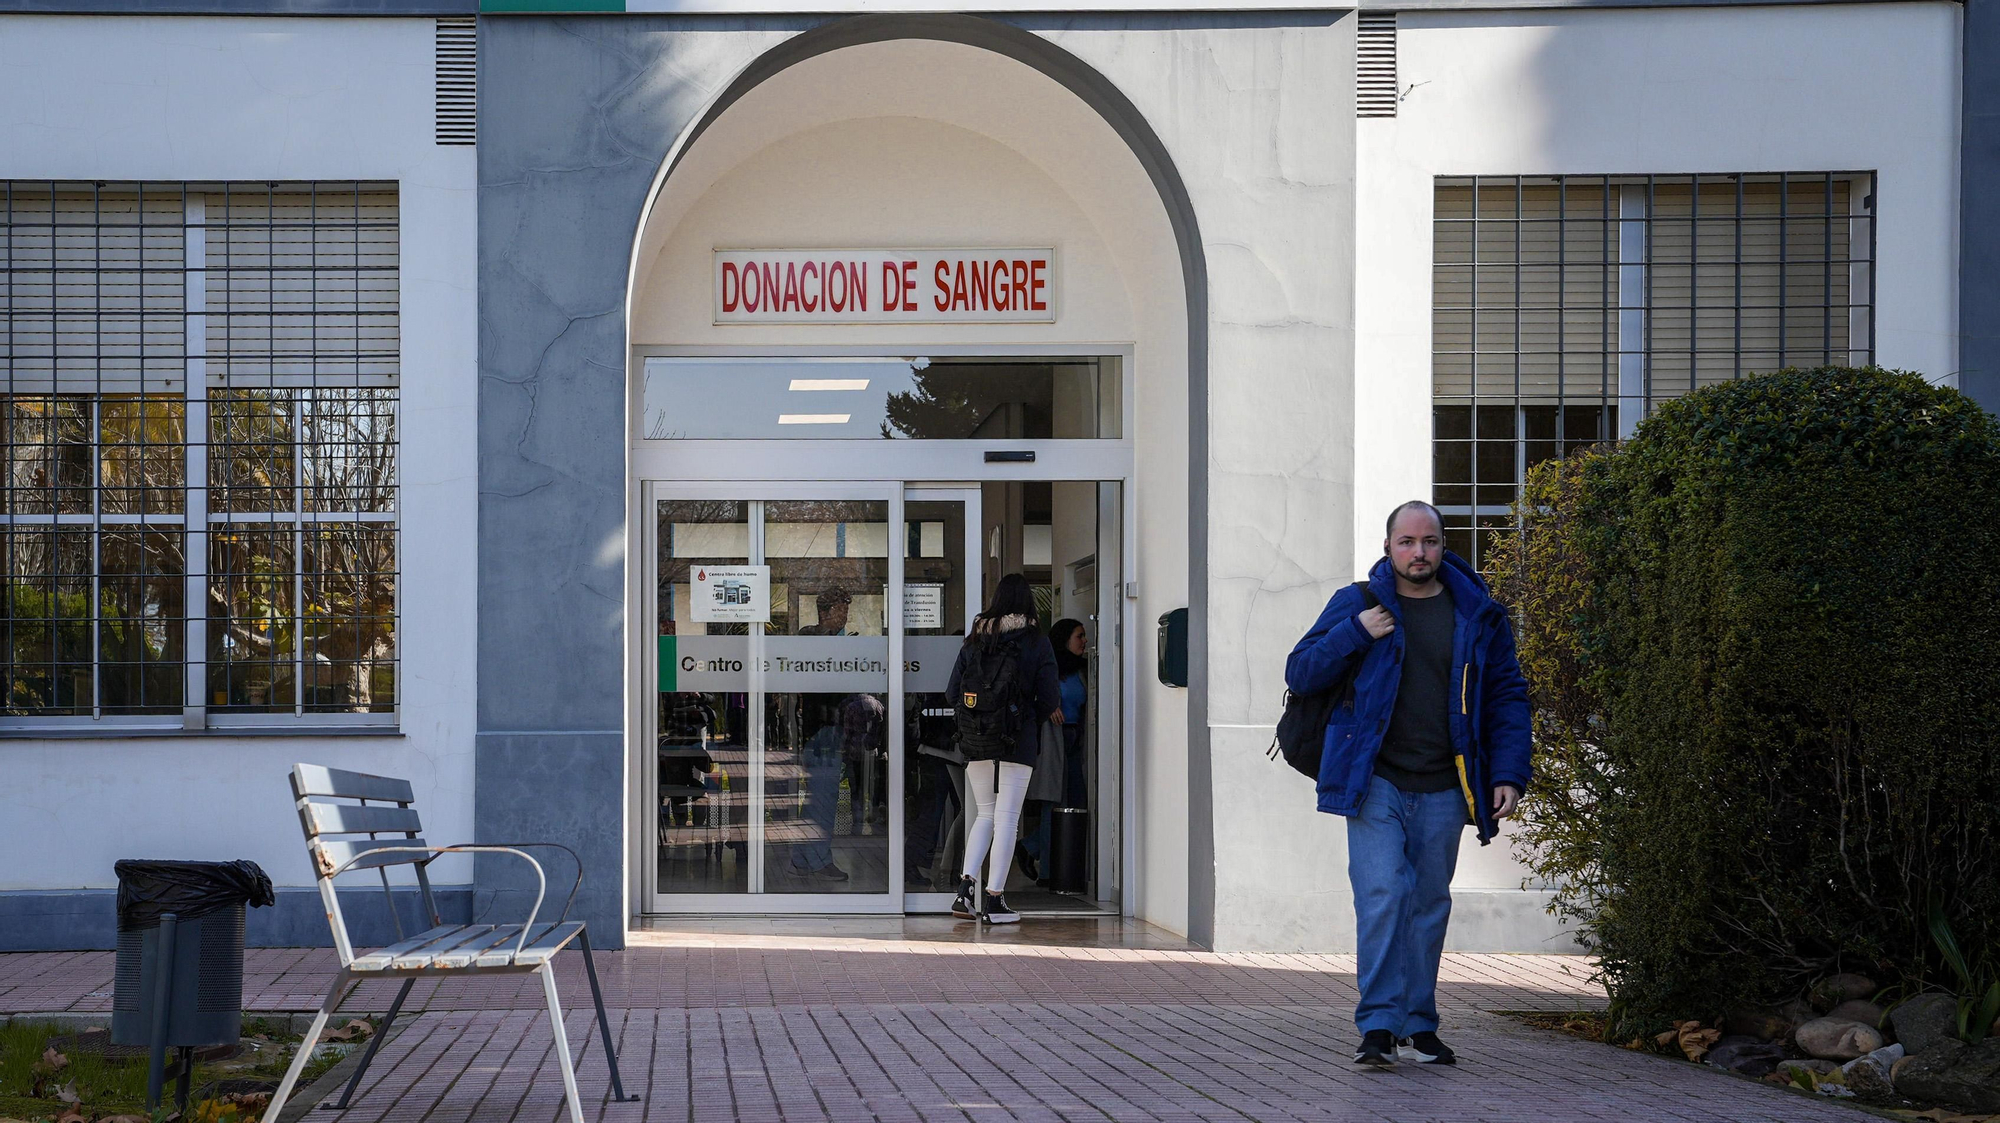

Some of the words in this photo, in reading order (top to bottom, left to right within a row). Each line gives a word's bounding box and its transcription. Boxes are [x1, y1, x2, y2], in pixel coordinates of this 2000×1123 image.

[722, 260, 867, 313] DONACION
[883, 260, 917, 312] DE
[933, 259, 1047, 312] SANGRE
[681, 656, 743, 672] Centro
[776, 656, 887, 675] Transfusión,
